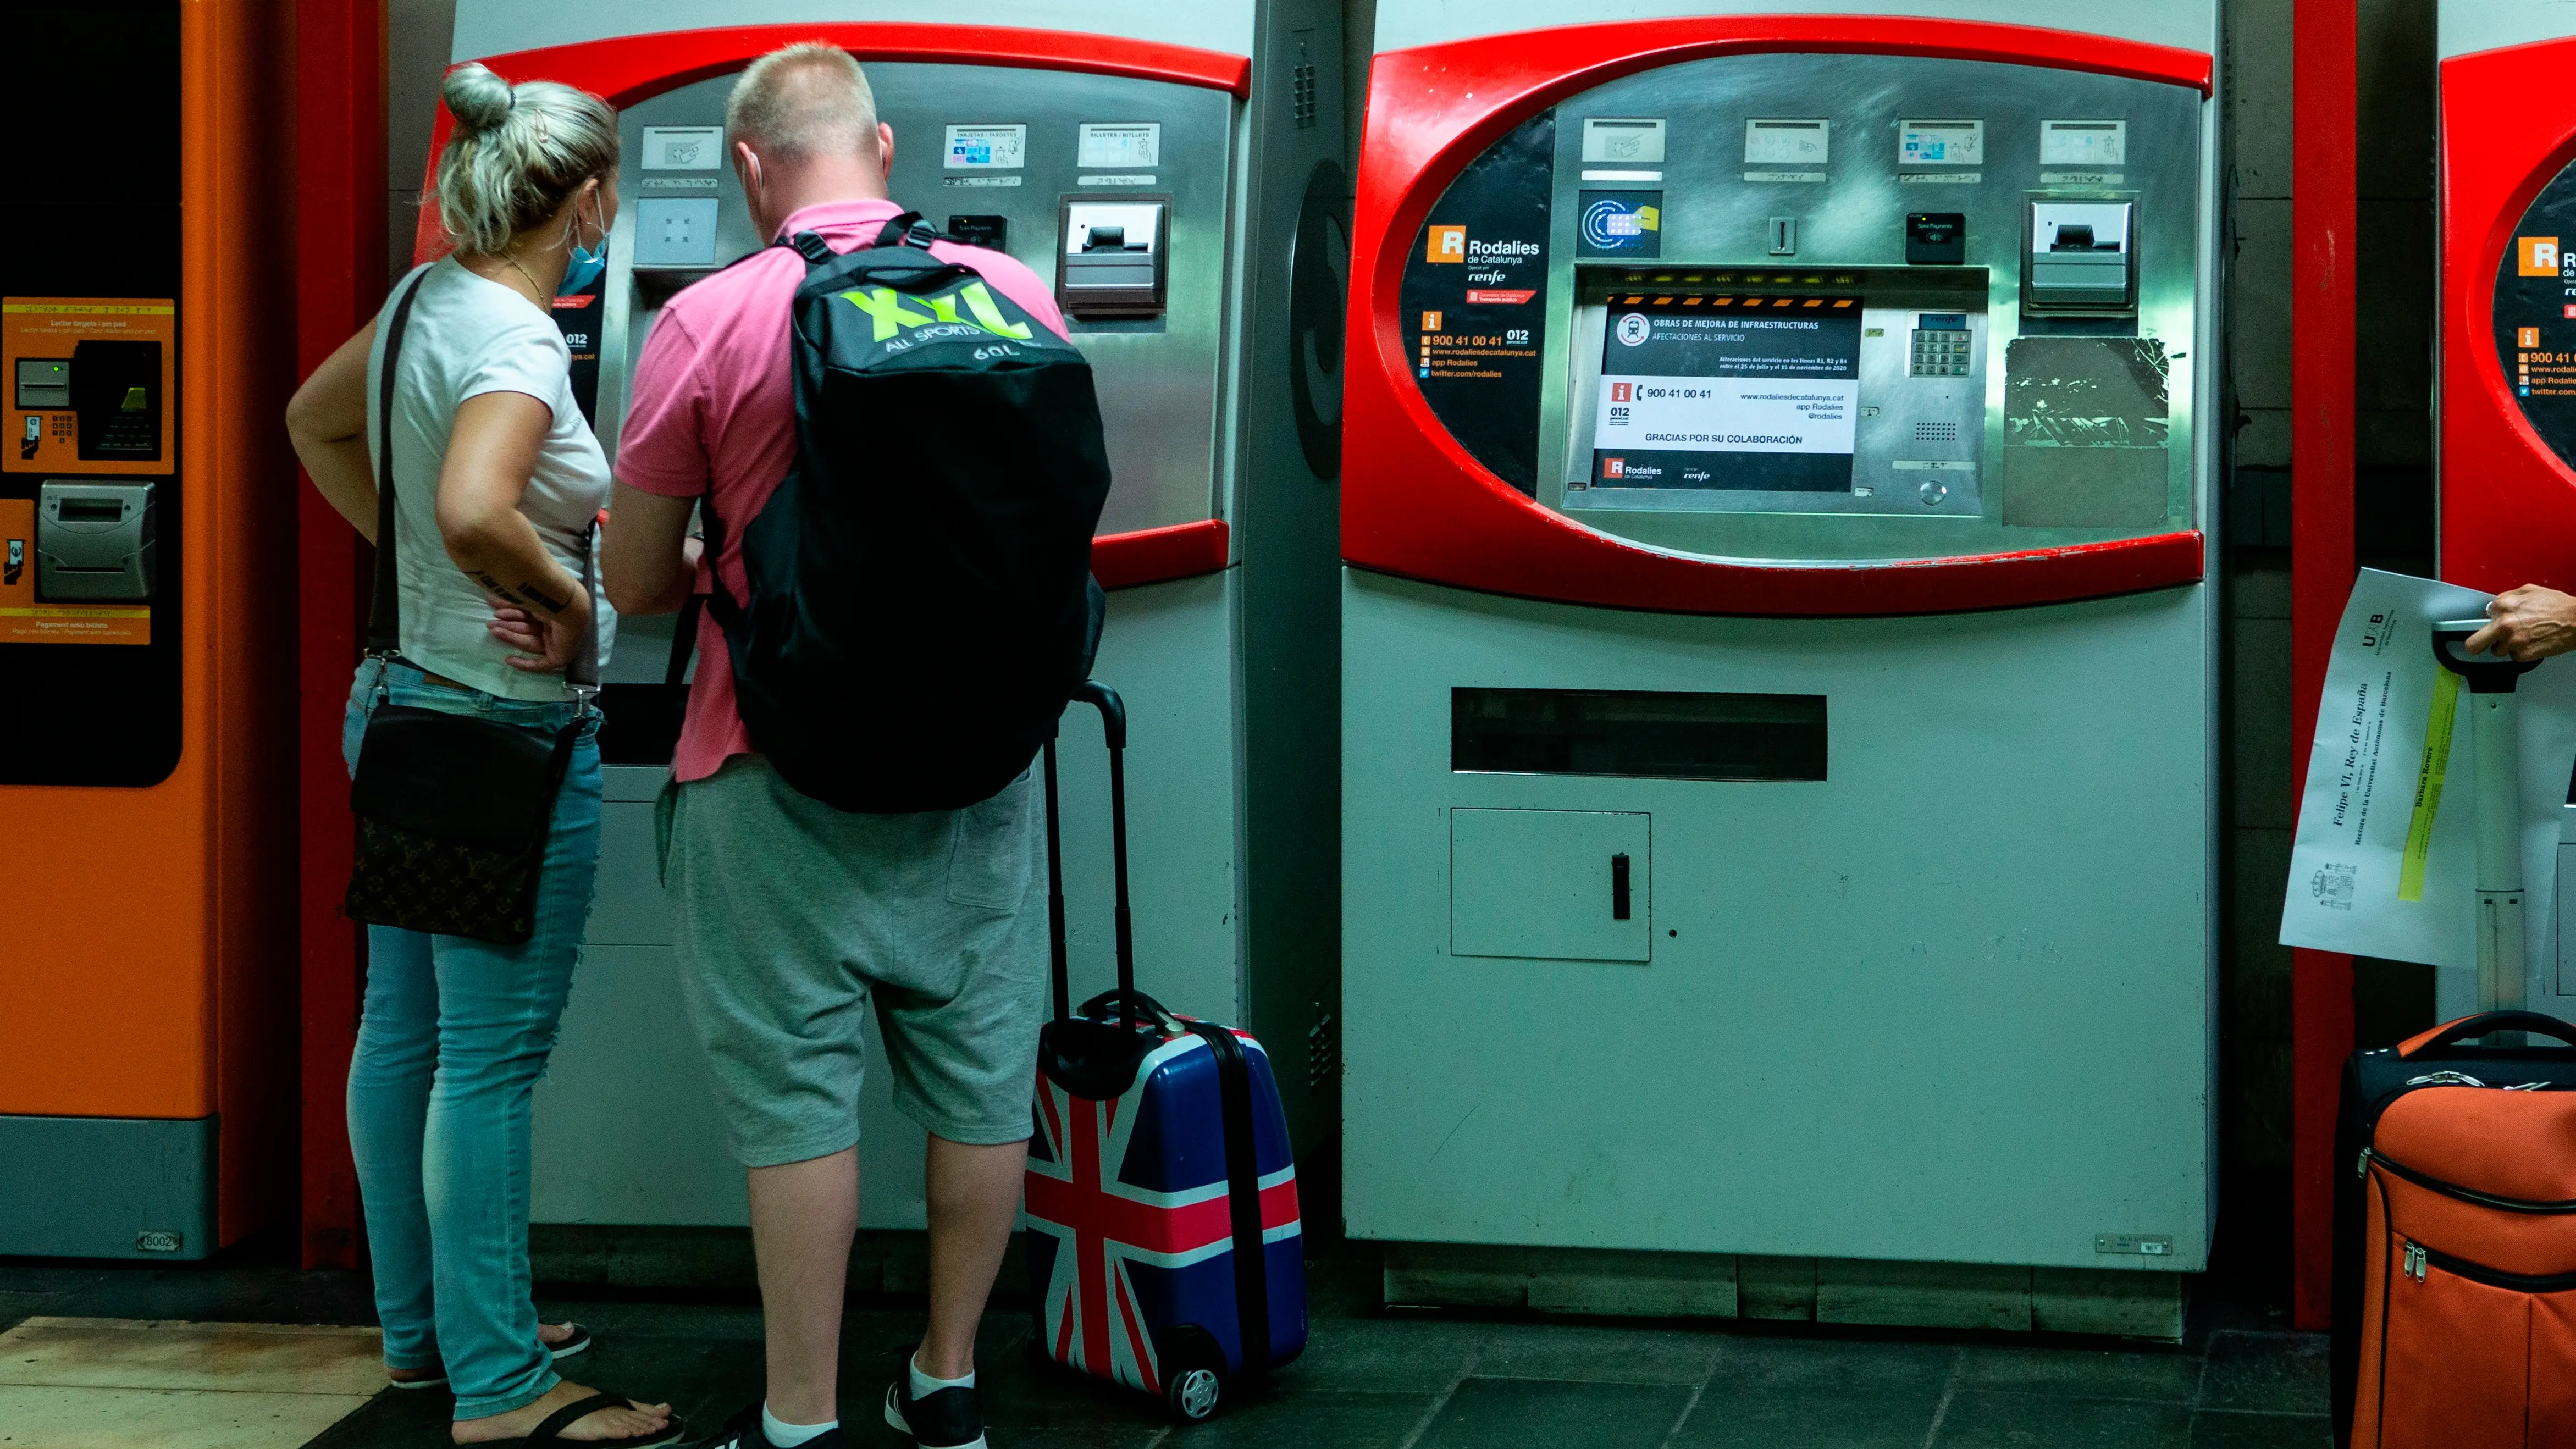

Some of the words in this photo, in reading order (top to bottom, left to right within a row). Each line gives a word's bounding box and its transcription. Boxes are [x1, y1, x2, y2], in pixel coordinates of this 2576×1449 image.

[1442, 231, 1464, 254] R
[1469, 240, 1539, 255] Rodalies
[1468, 255, 1479, 263] de
[1480, 255, 1522, 266] Catalunya
[2534, 243, 2558, 267] R
[1468, 270, 1506, 285] renfe
[2563, 268, 2575, 277] de
[1654, 319, 1680, 328] OBRAS
[1695, 320, 1726, 329] MEJORA
[1741, 321, 1819, 329] INFRAESTRUCTURAS
[566, 334, 588, 344] 012
[886, 338, 914, 352] ALL
[914, 324, 980, 341] SPORTS
[1507, 330, 1528, 340] 012
[1652, 333, 1702, 341] AFECTACIONES
[1433, 336, 1453, 346] 900
[1456, 336, 1468, 346] 41
[1473, 336, 1486, 346] 00
[1489, 336, 1502, 346] 41
[974, 344, 1021, 360] 60L
[1432, 349, 1536, 357] www.rodaliesdecatalunya.cat
[2530, 352, 2552, 363] 900
[2556, 353, 2569, 363] 41
[1647, 389, 1666, 397] 900
[1668, 389, 1680, 398] 41
[1684, 389, 1696, 398] 00
[1700, 390, 1711, 399] 41
[1740, 393, 1844, 402] www.rodaliesdecatalunya.cat
[1610, 407, 1629, 416] 012
[1645, 433, 1687, 442] GRACIAS
[1727, 434, 1803, 444] COLABORACIÓN
[1611, 461, 1623, 474] R
[1625, 467, 1662, 475] Rodalies
[1684, 471, 1710, 482] renfe
[2380, 672, 2391, 707] Barcelona
[2352, 682, 2368, 726] España
[2378, 709, 2385, 718] de
[2351, 729, 2360, 744] de
[2345, 746, 2359, 769] Rey
[2422, 746, 2433, 775] Rovere
[2340, 771, 2354, 789] VI,
[2364, 759, 2377, 798] Universitat
[2333, 792, 2348, 827] Felipe
[2361, 806, 2368, 817] de
[2354, 817, 2365, 845] Rectora
[147, 1236, 172, 1246] 8002
